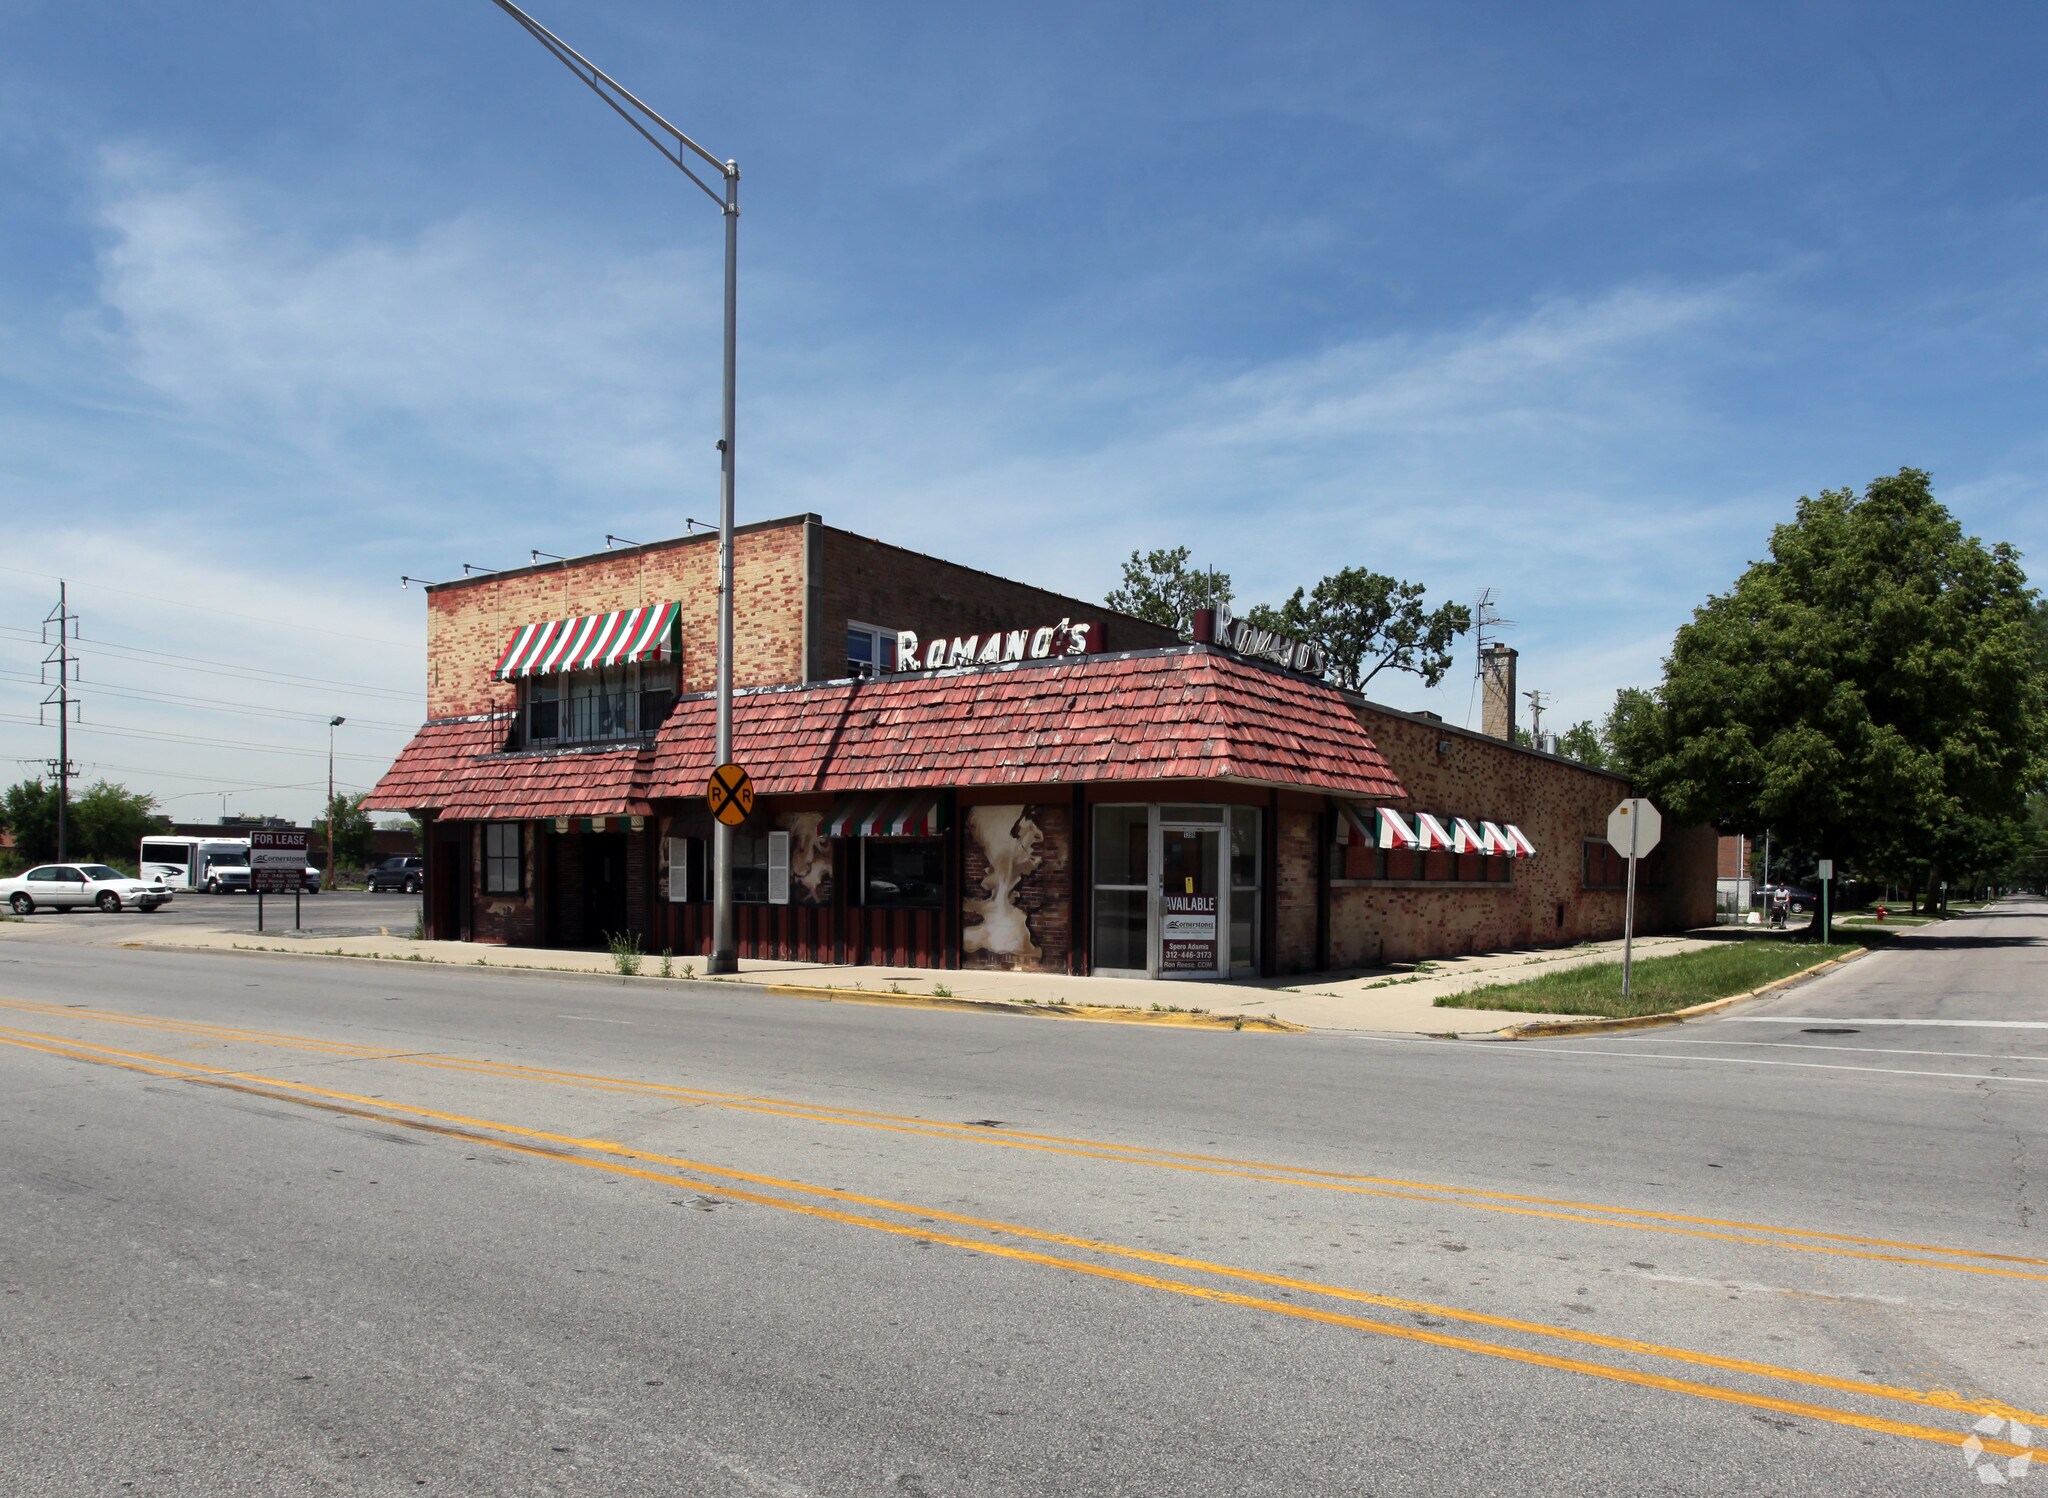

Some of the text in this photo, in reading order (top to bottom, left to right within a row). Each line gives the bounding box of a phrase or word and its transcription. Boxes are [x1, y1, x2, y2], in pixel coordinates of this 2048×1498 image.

[897, 617, 1091, 672] ROMANO'S
[1214, 599, 1326, 676] ROMANO'S
[711, 787, 751, 803] R R
[254, 834, 305, 845] FOR LEASE
[1166, 897, 1215, 911] AVAILABLE
[1169, 943, 1187, 951] Spero
